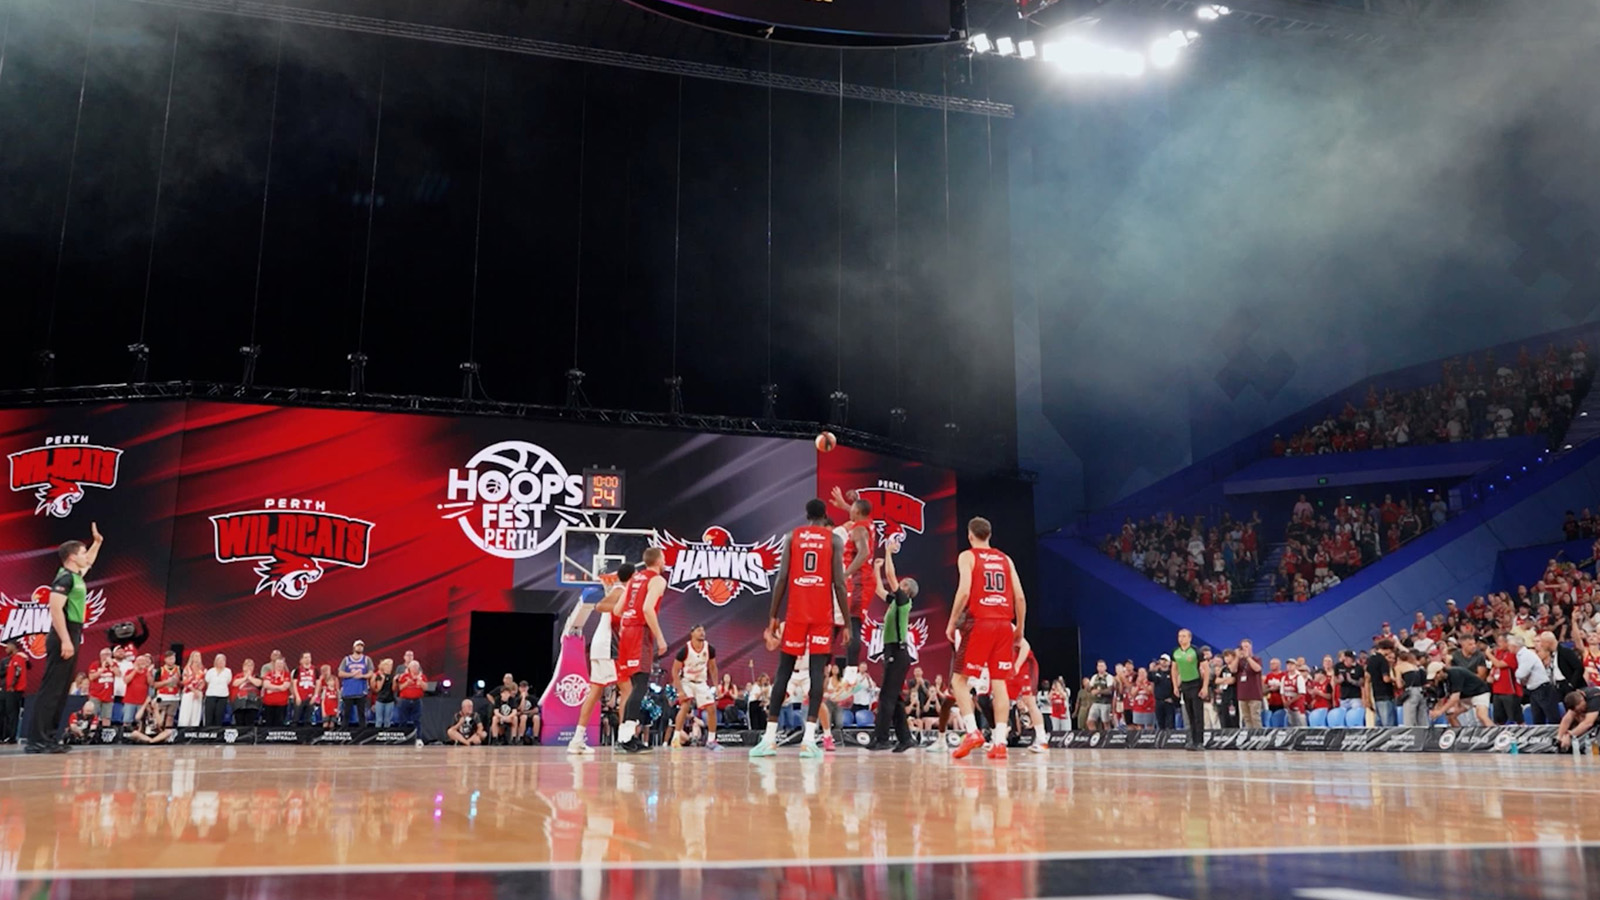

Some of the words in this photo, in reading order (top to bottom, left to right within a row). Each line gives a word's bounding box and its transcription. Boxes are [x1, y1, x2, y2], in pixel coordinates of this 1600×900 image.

[45, 435, 89, 445] PERTH
[12, 447, 117, 487] WILDCATS
[447, 468, 584, 507] HOOPS
[592, 475, 619, 488] 10:00
[878, 479, 905, 491] PERTH
[265, 498, 326, 511] PERTH
[591, 488, 616, 508] 24
[482, 503, 547, 528] FEST
[217, 514, 368, 563] WILDCATS
[484, 529, 538, 550] PERTH
[671, 549, 768, 590] HAWKS
[803, 551, 817, 573] 0
[984, 571, 1006, 592] 10
[1, 608, 52, 643] HAW
